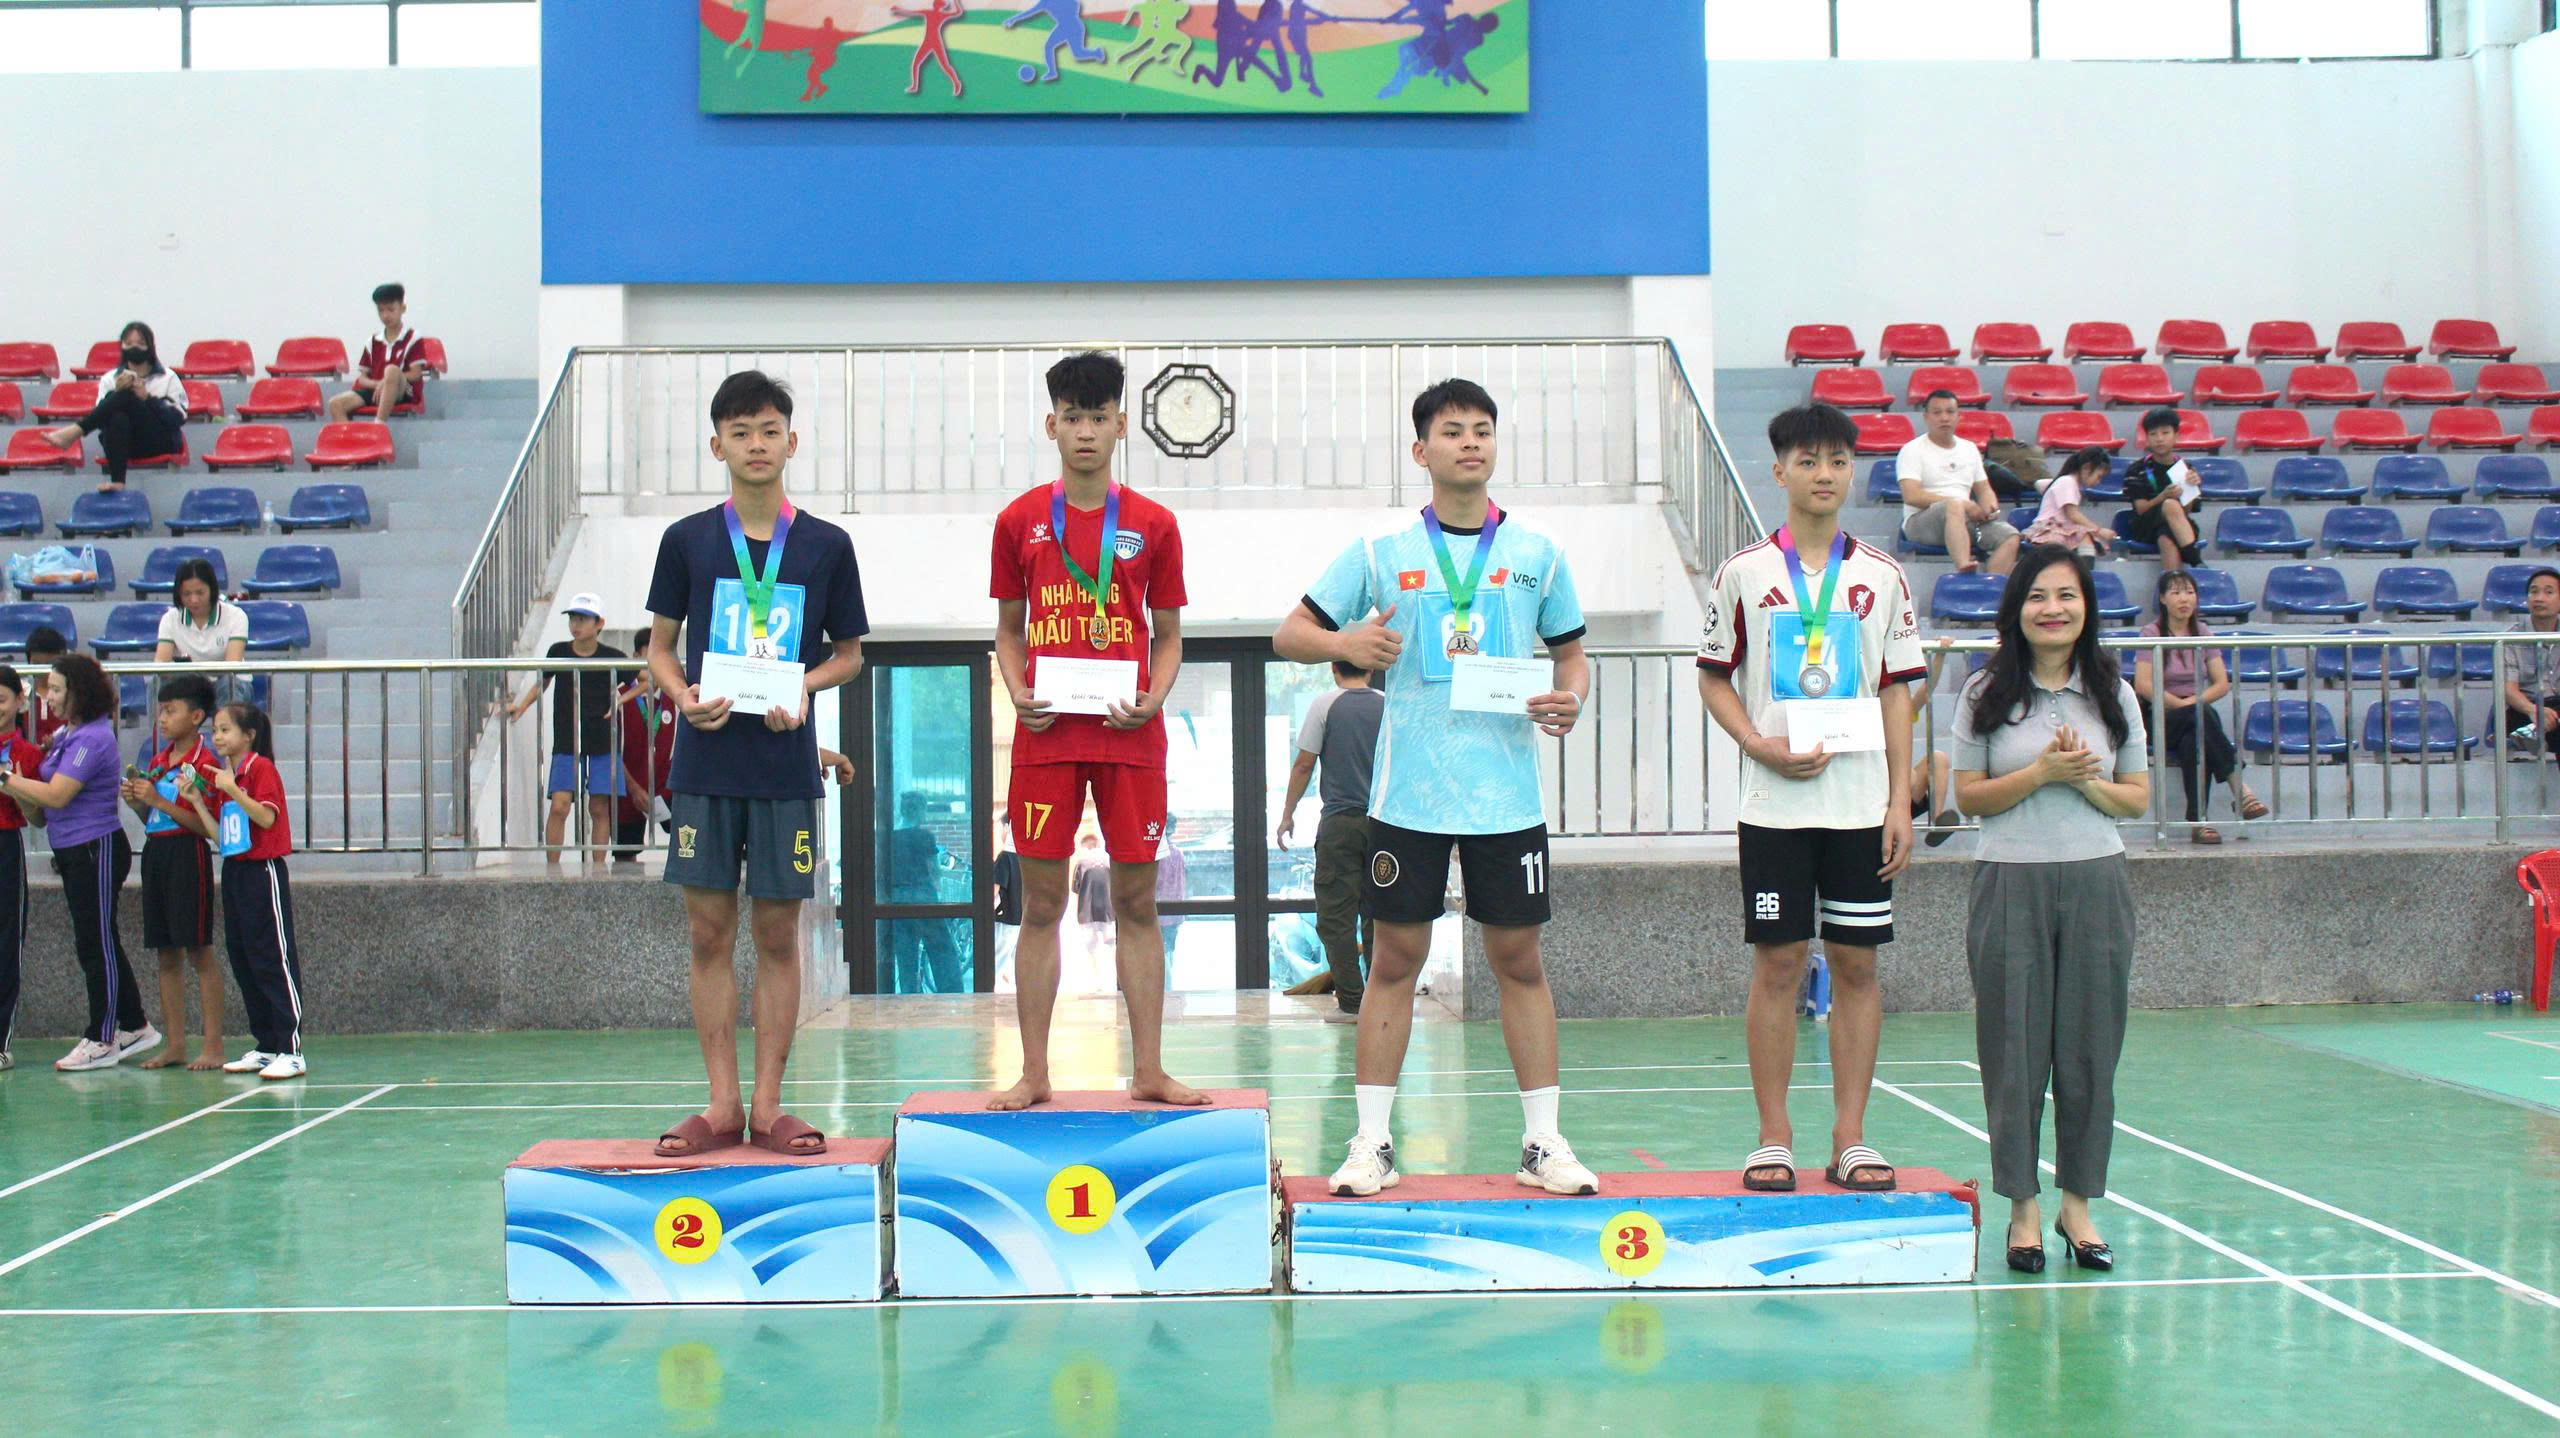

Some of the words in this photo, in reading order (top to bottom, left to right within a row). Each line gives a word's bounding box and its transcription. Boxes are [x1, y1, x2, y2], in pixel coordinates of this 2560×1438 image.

[1029, 536, 1052, 544] KELME
[1041, 579, 1074, 607] NHÀ
[1512, 571, 1538, 588] VRC
[1029, 608, 1071, 648] MẨU
[1024, 801, 1054, 841] 17
[793, 829, 813, 874] 5
[1520, 850, 1544, 895] 11
[1755, 892, 1780, 913] 26
[1064, 1182, 1097, 1218] 1
[672, 1213, 705, 1249] 2
[1615, 1226, 1649, 1260] 3
